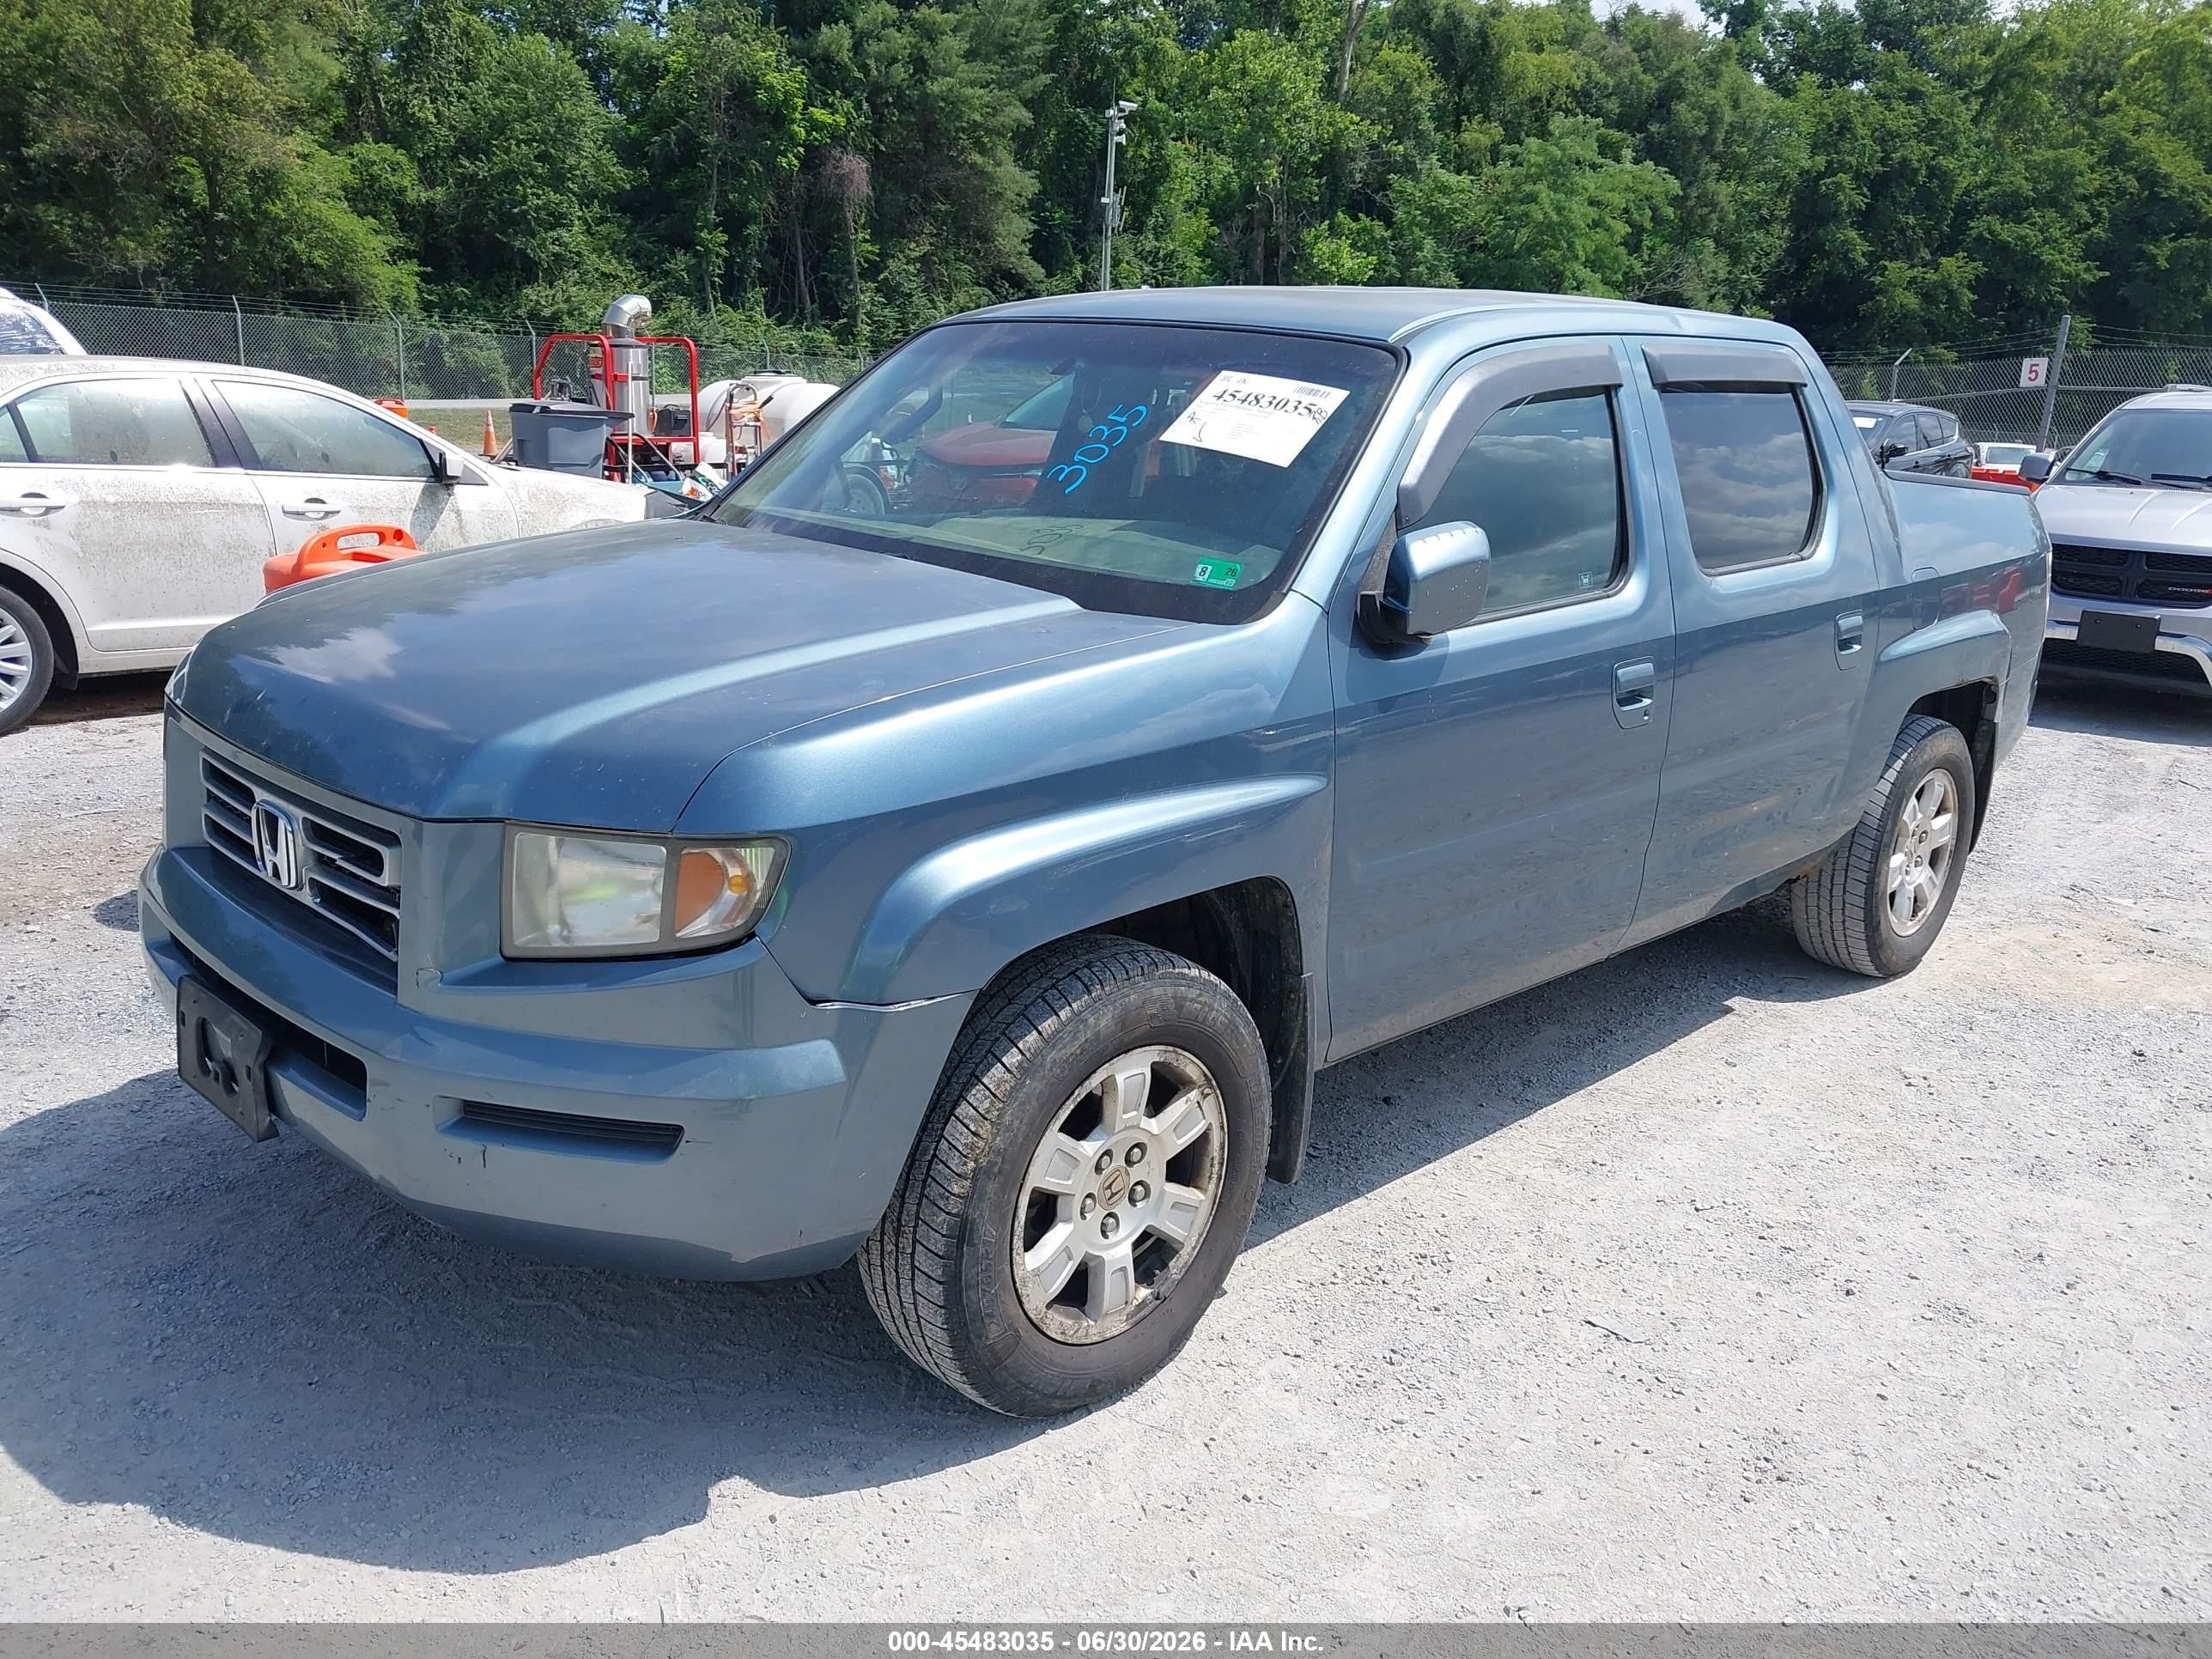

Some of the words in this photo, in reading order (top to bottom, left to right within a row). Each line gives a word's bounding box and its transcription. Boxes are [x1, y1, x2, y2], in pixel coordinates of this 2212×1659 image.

[2027, 363, 2040, 382] 5
[1212, 388, 1319, 417] 45483035
[1047, 404, 1147, 495] 3035
[1198, 566, 1209, 577] 8
[1224, 567, 1238, 577] 26
